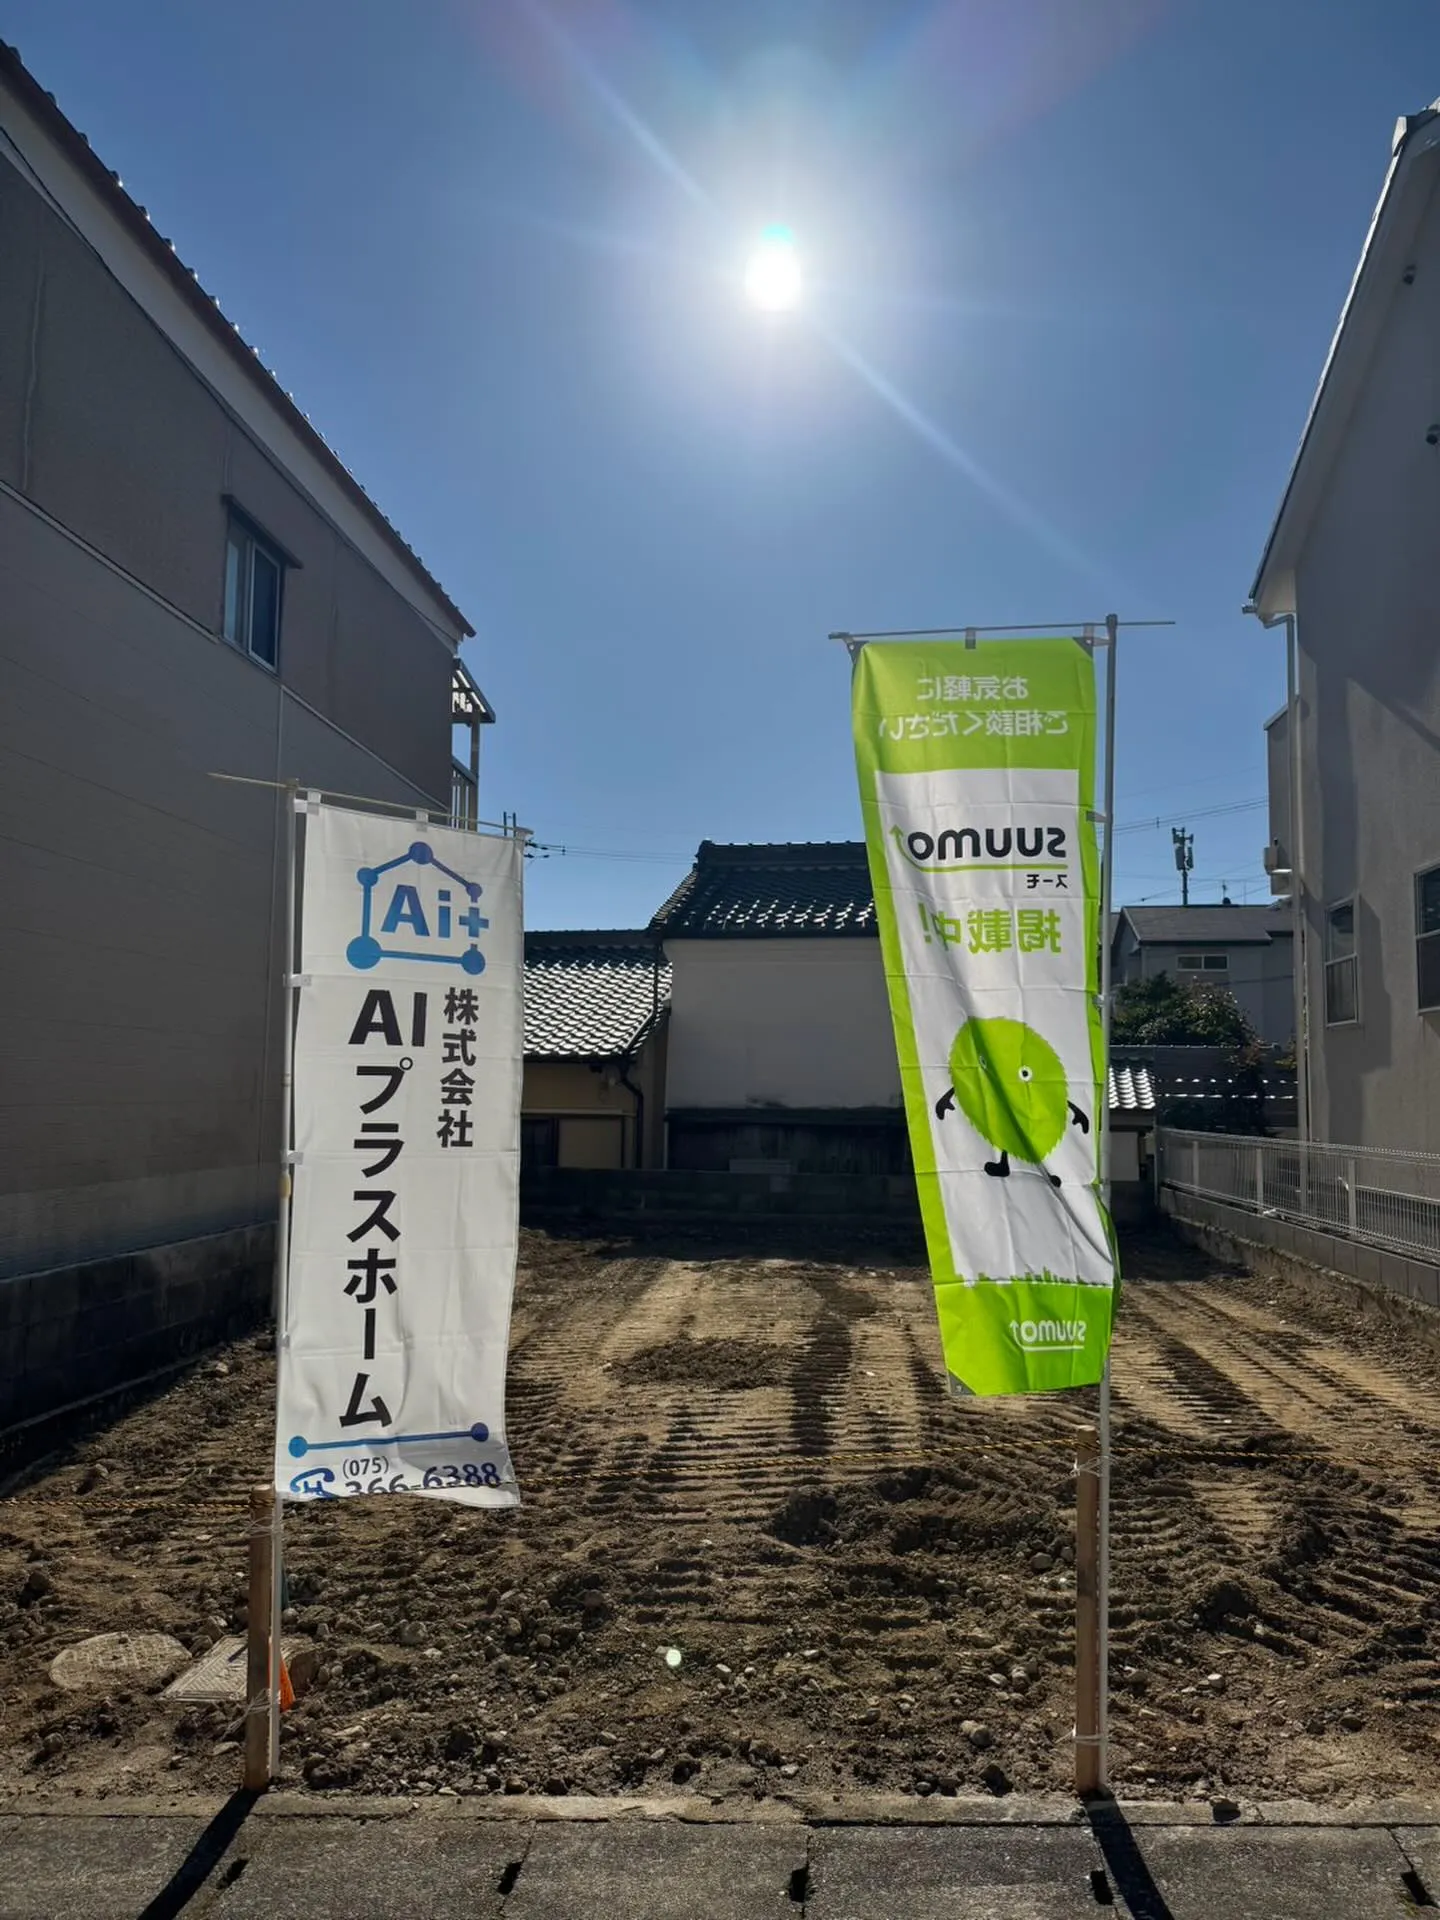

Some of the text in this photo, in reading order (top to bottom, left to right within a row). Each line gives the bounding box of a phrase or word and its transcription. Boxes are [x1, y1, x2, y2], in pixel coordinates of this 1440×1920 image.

[381, 884, 489, 938] Ai+
[436, 986, 479, 1149] 株式会社
[339, 989, 428, 1427] AIプラスホーム
[343, 1456, 389, 1479] (075)
